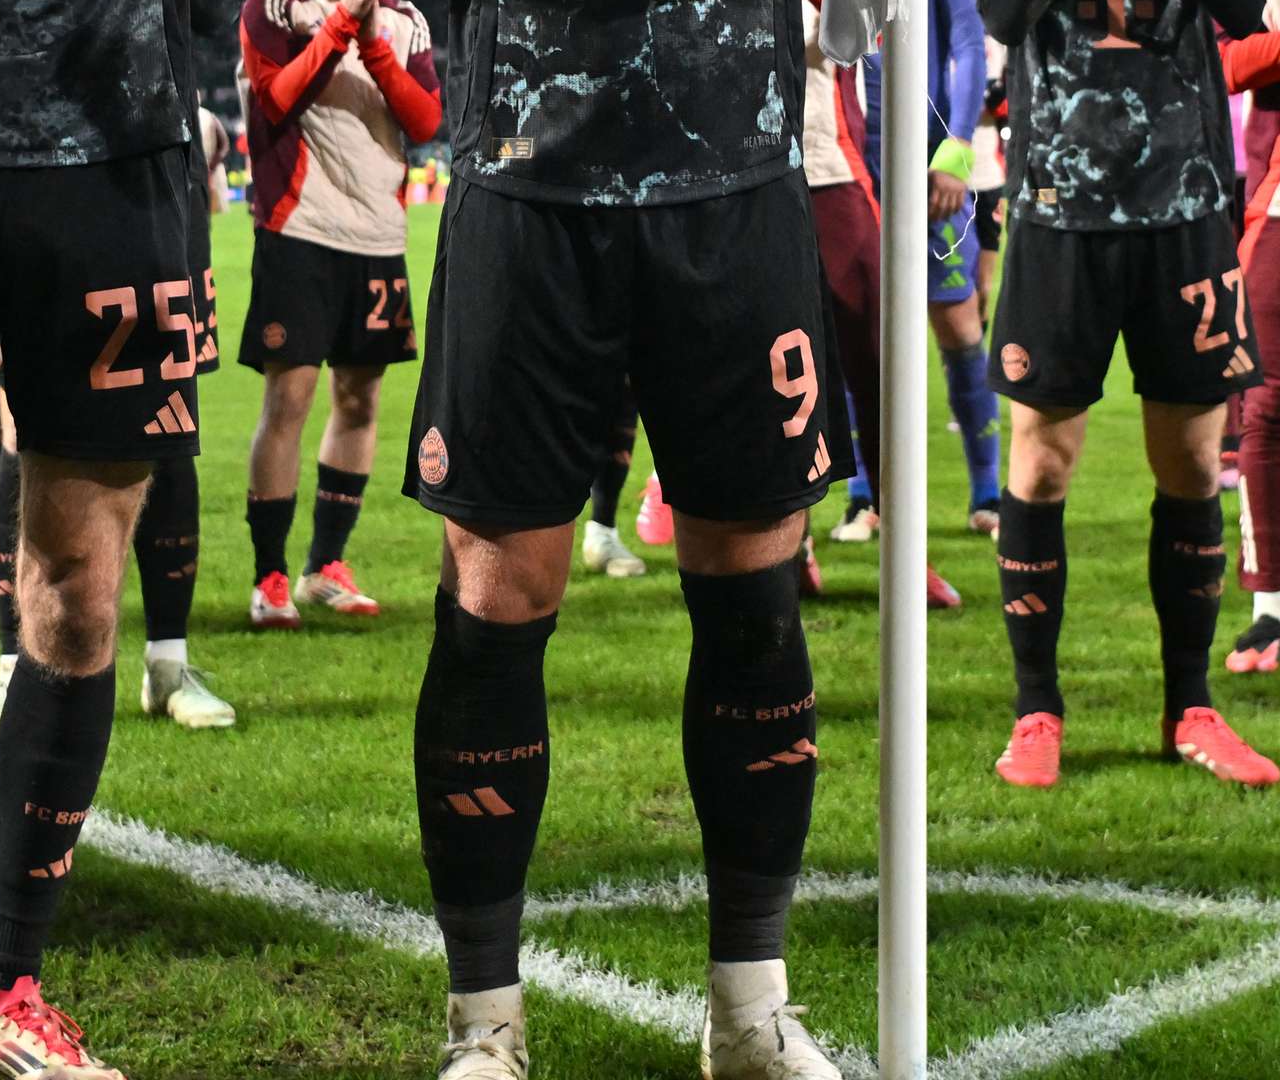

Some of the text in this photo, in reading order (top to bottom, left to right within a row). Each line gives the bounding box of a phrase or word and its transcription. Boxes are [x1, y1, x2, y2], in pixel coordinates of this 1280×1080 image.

[85, 279, 197, 390] 25
[366, 278, 412, 329] 22
[769, 329, 819, 438] 9
